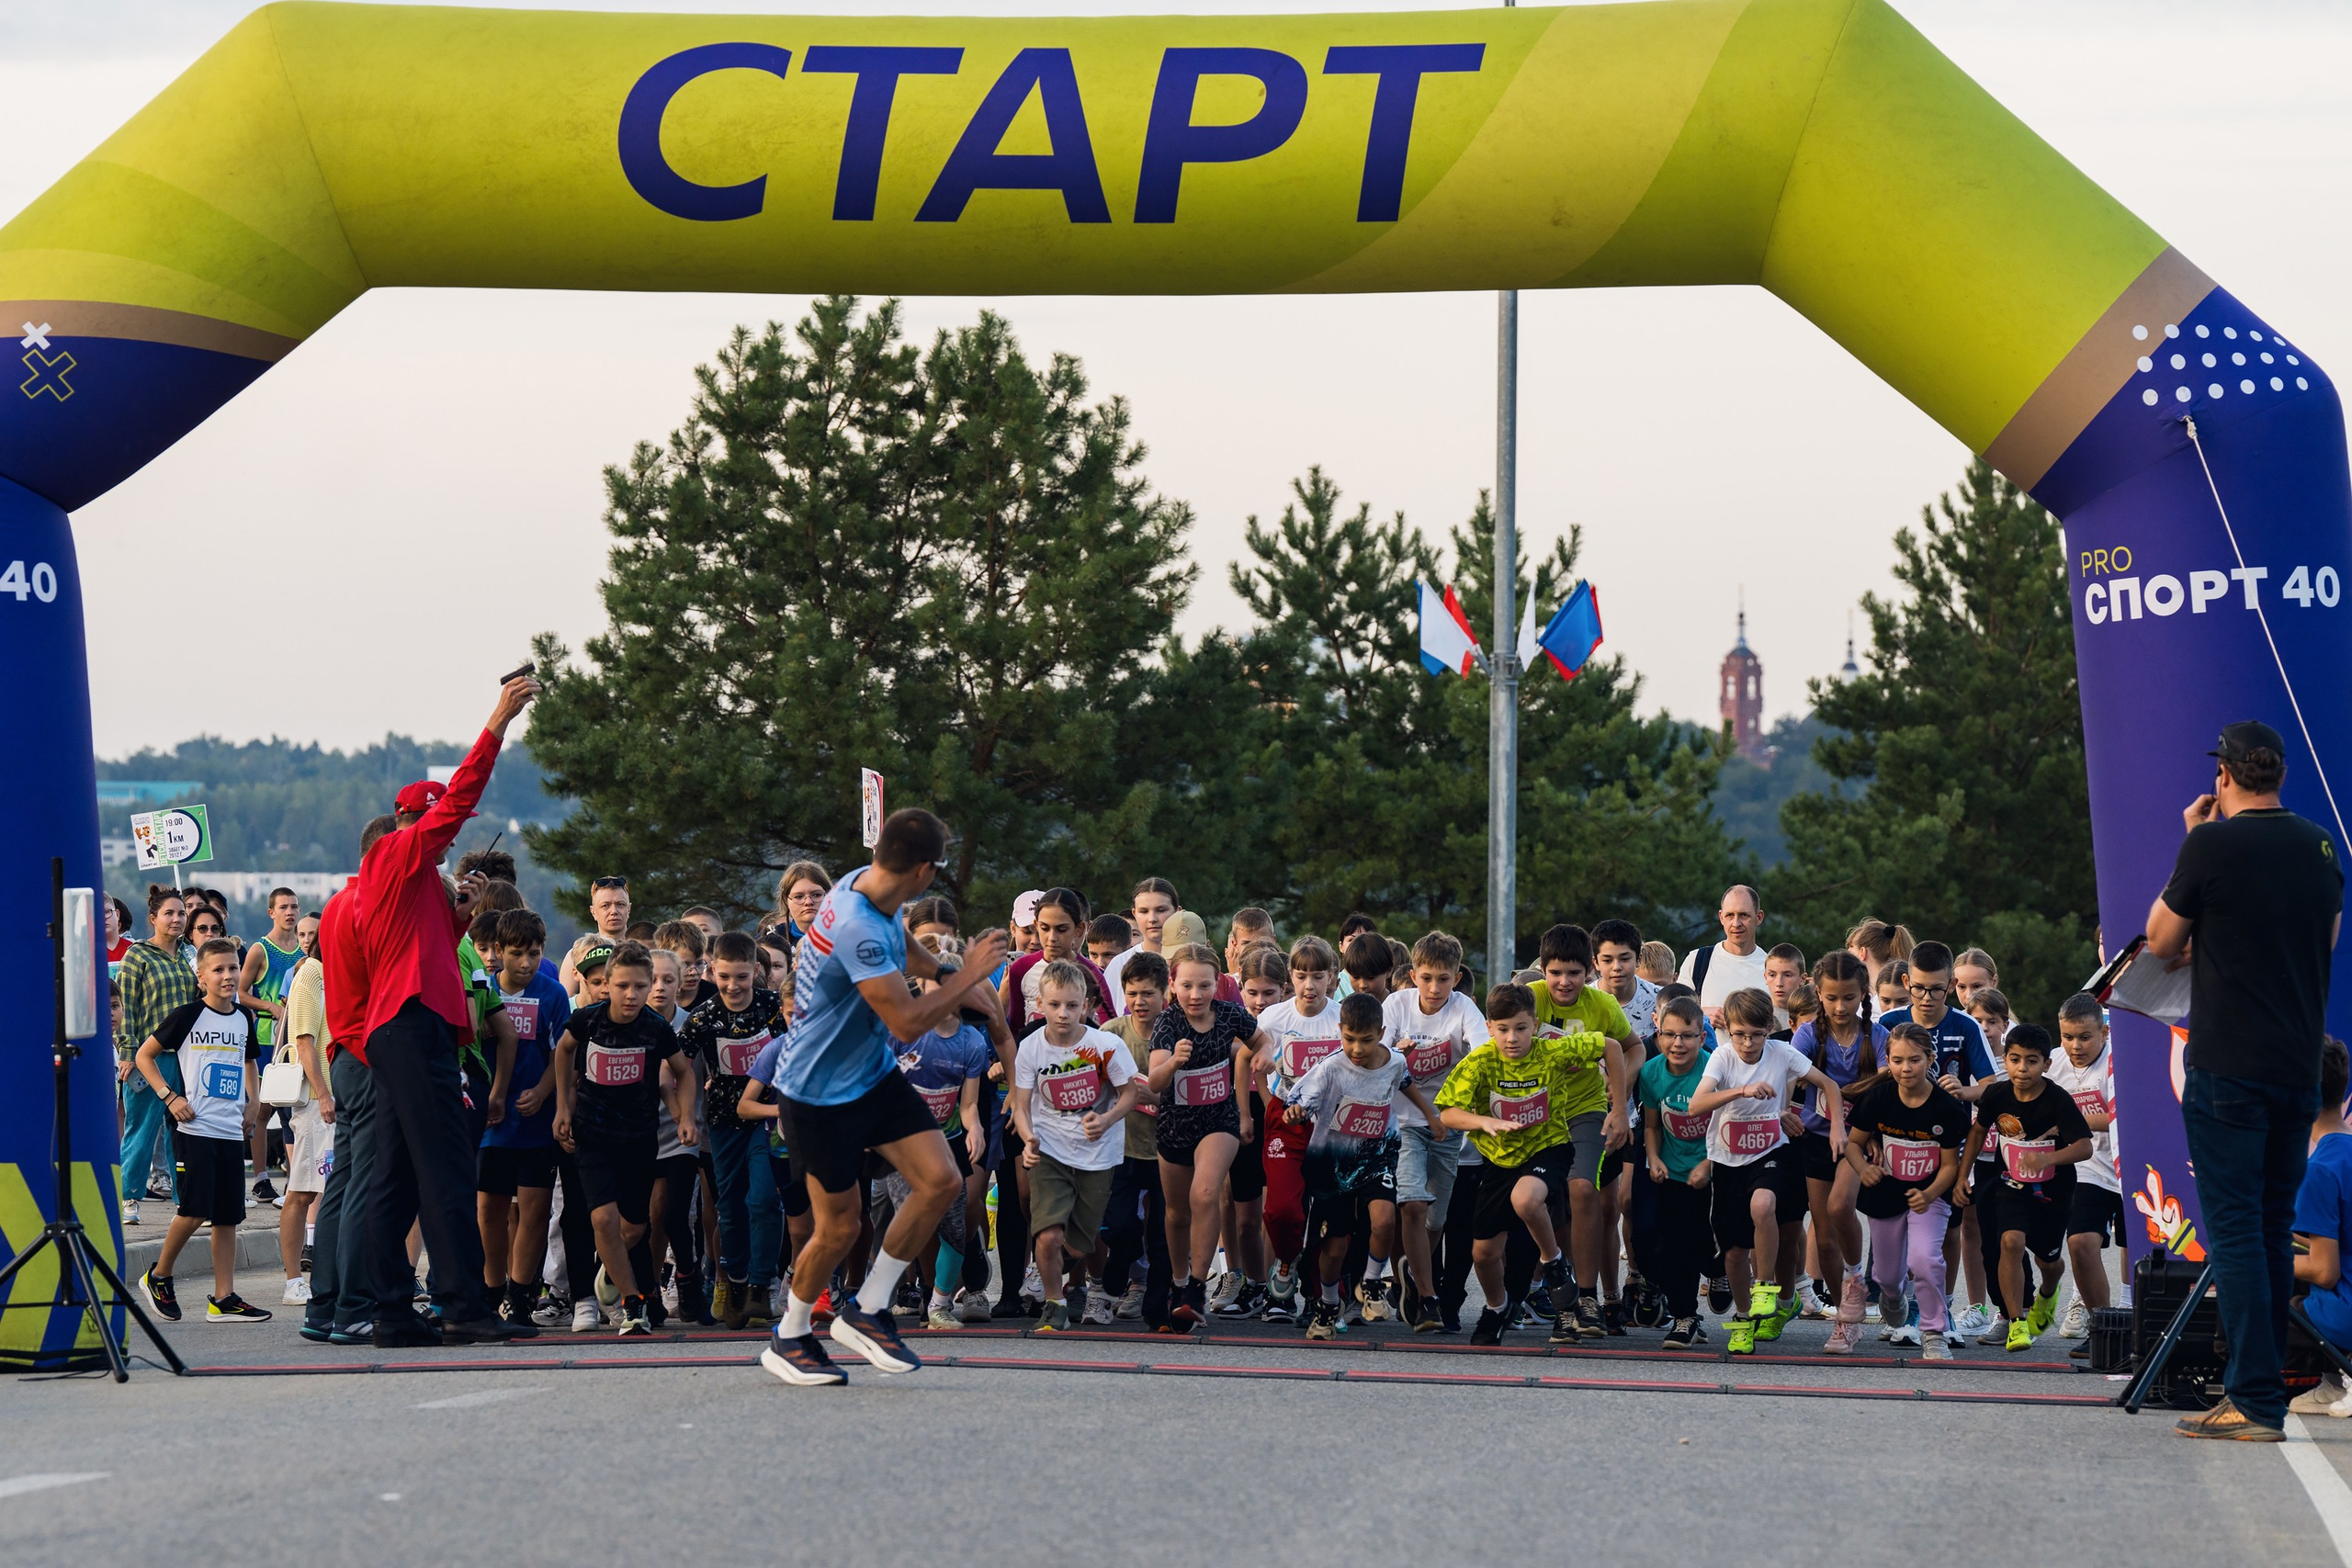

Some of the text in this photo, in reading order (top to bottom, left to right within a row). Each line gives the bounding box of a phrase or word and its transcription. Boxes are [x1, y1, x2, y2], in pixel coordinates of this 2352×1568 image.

[616, 41, 1487, 224] СТАРТ
[2081, 546, 2132, 577] PRO
[0, 560, 57, 603] 40
[2085, 566, 2340, 625] СПОРТ 40
[165, 818, 183, 827] 19:00
[167, 831, 184, 843] 1 КМ
[507, 1006, 524, 1014] ИЛЬЯ
[509, 1016, 532, 1034] 95
[746, 1043, 762, 1054] ГЛЕБ
[1307, 1046, 1329, 1055] СОФЬЯ
[1418, 1047, 1442, 1058] АНДРЕЙ
[608, 1055, 635, 1064] ЕВГЕНИЙ
[740, 1054, 760, 1071] 18
[1413, 1053, 1447, 1072] 4206
[220, 1069, 239, 1077] ТИМОФЕЙ
[606, 1065, 639, 1081] 1529
[1200, 1072, 1224, 1084] МАРИНА
[220, 1078, 238, 1096] 589
[1063, 1078, 1088, 1090] НИКИТА
[1200, 1080, 1226, 1100] 759
[927, 1096, 947, 1104] МАРИЯ
[1059, 1086, 1096, 1106] 3385
[1519, 1103, 1534, 1112] ГЛЕБ
[1363, 1111, 1383, 1119] ДАВИД
[1510, 1106, 1544, 1126] 3866
[1686, 1116, 1701, 1124] ЕГОР
[1350, 1118, 1385, 1135] 3203
[1747, 1123, 1763, 1132] ОЛЕГ
[1737, 1133, 1775, 1149] 4667
[1904, 1150, 1929, 1158] УЛЬЯНА
[1900, 1158, 1934, 1176] 1674
